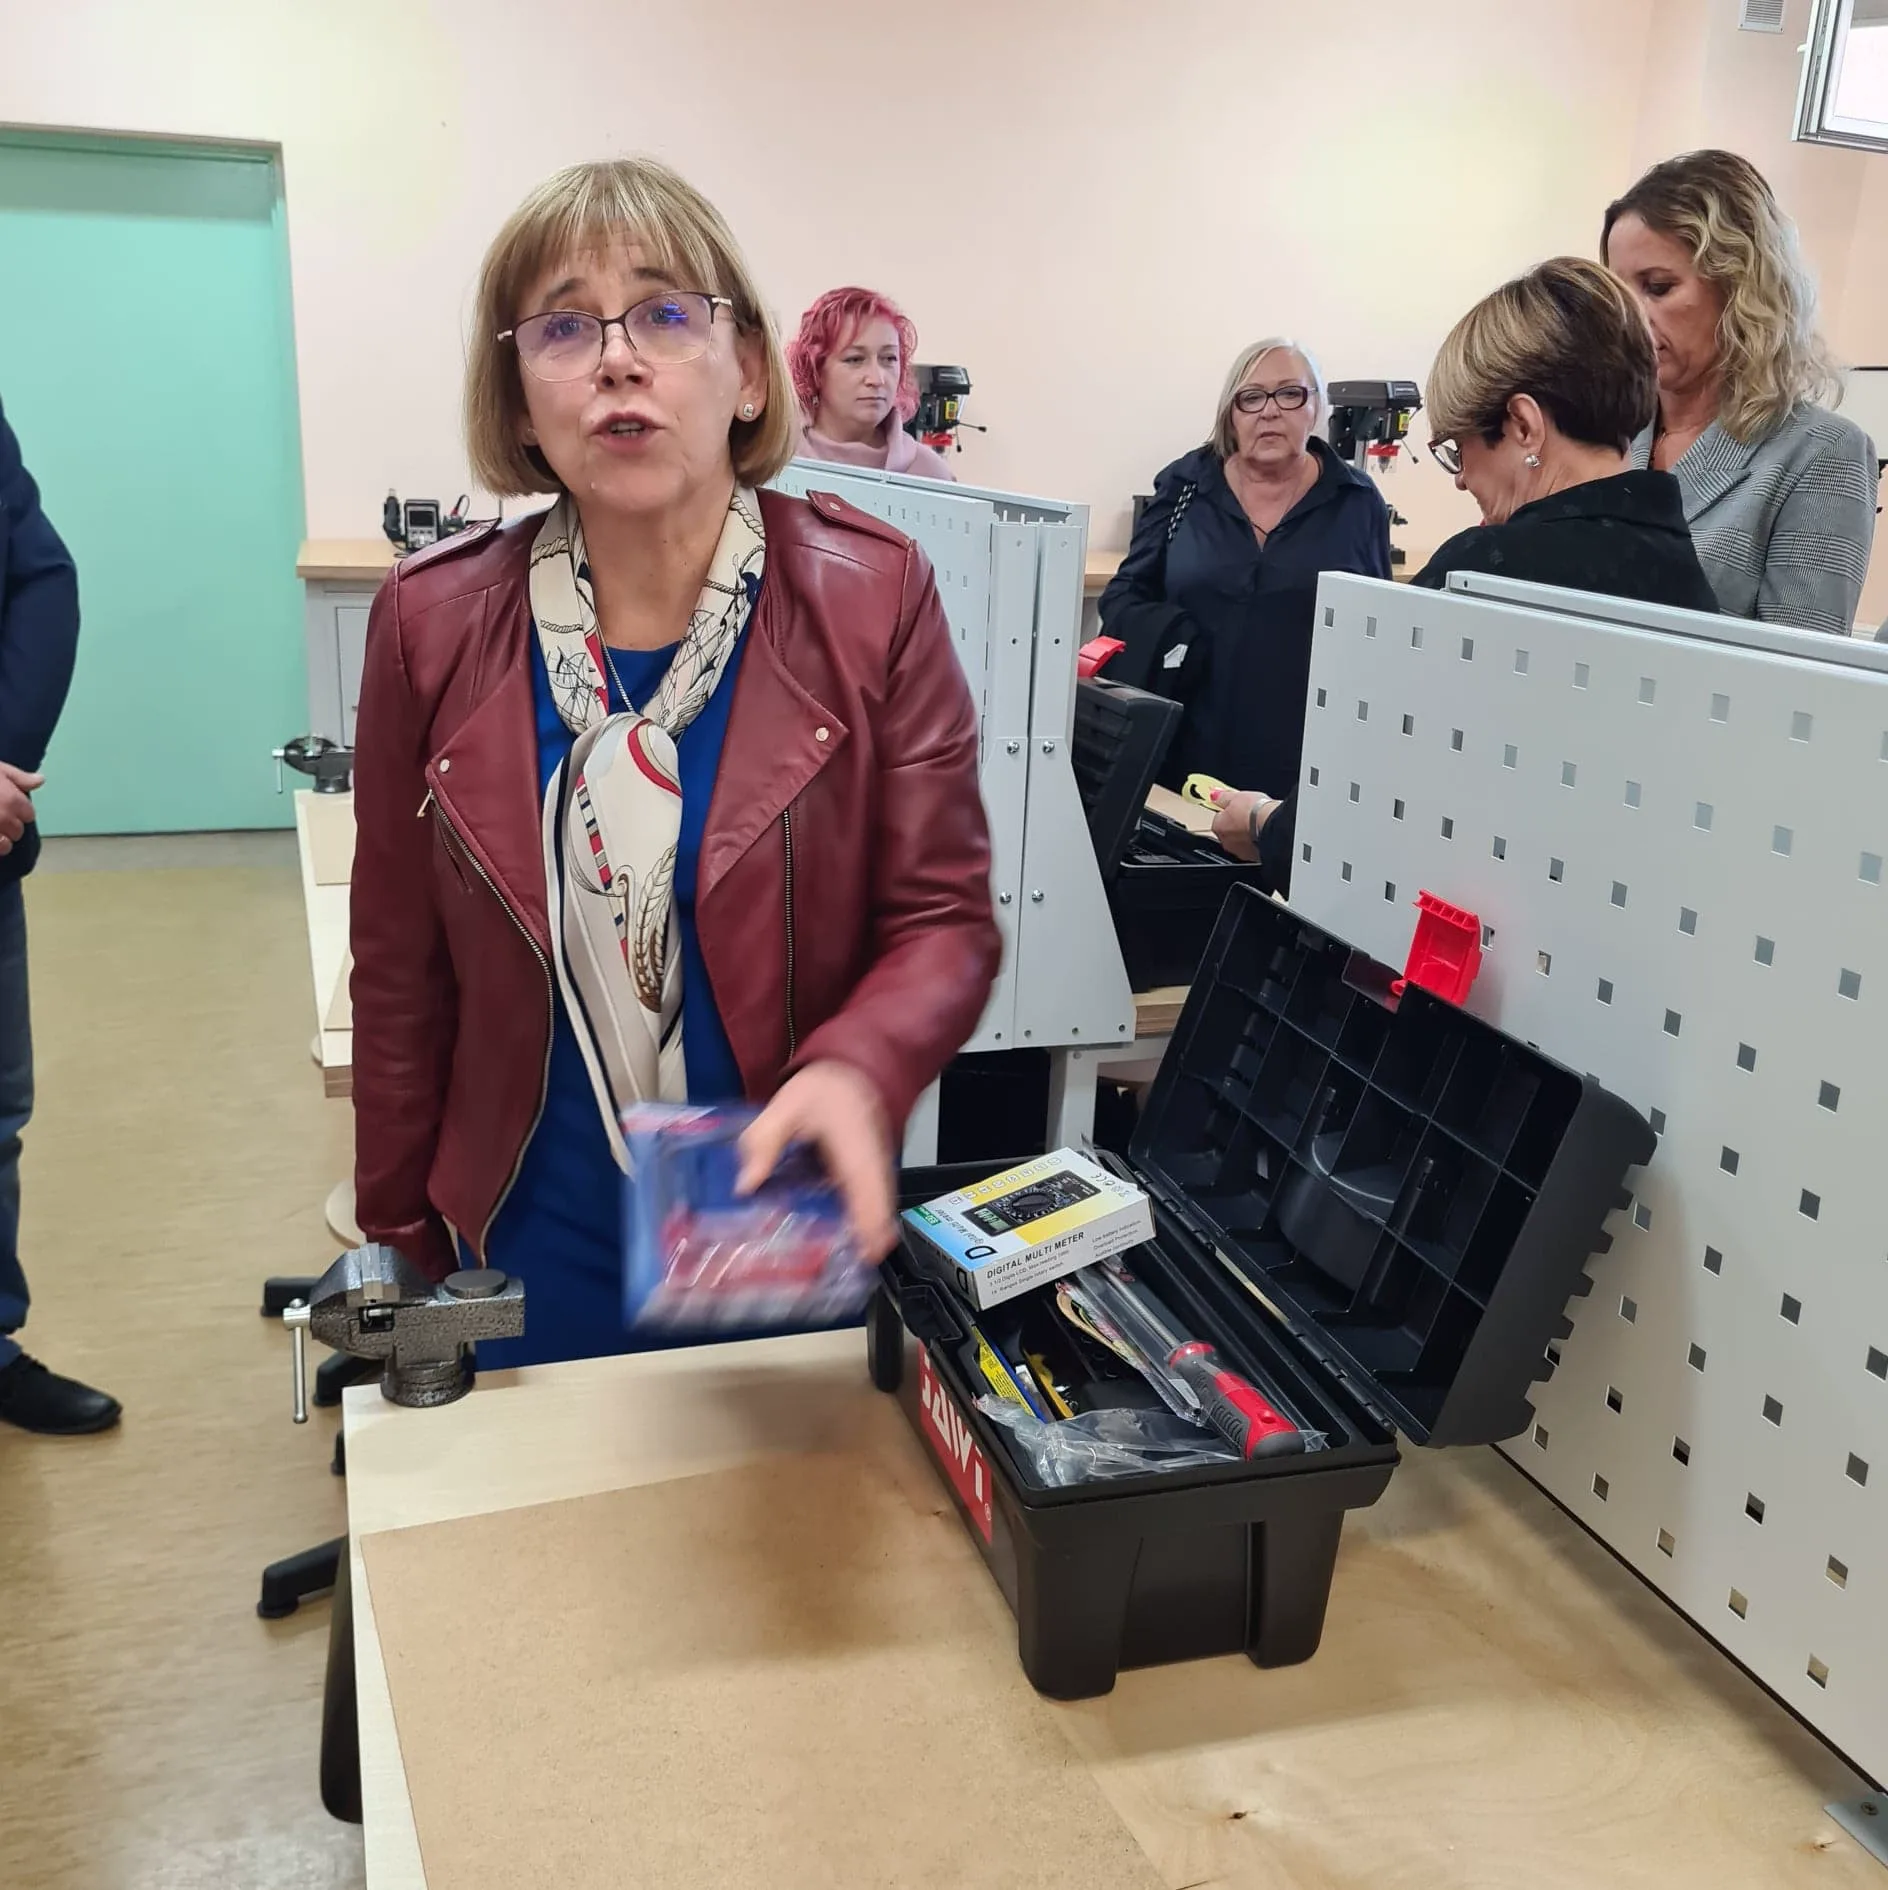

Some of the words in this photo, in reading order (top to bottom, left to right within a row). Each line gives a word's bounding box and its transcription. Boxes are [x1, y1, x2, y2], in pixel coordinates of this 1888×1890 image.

[986, 1258, 1023, 1279] DIGITAL
[1025, 1245, 1052, 1263] MULTI
[1054, 1231, 1084, 1250] METER
